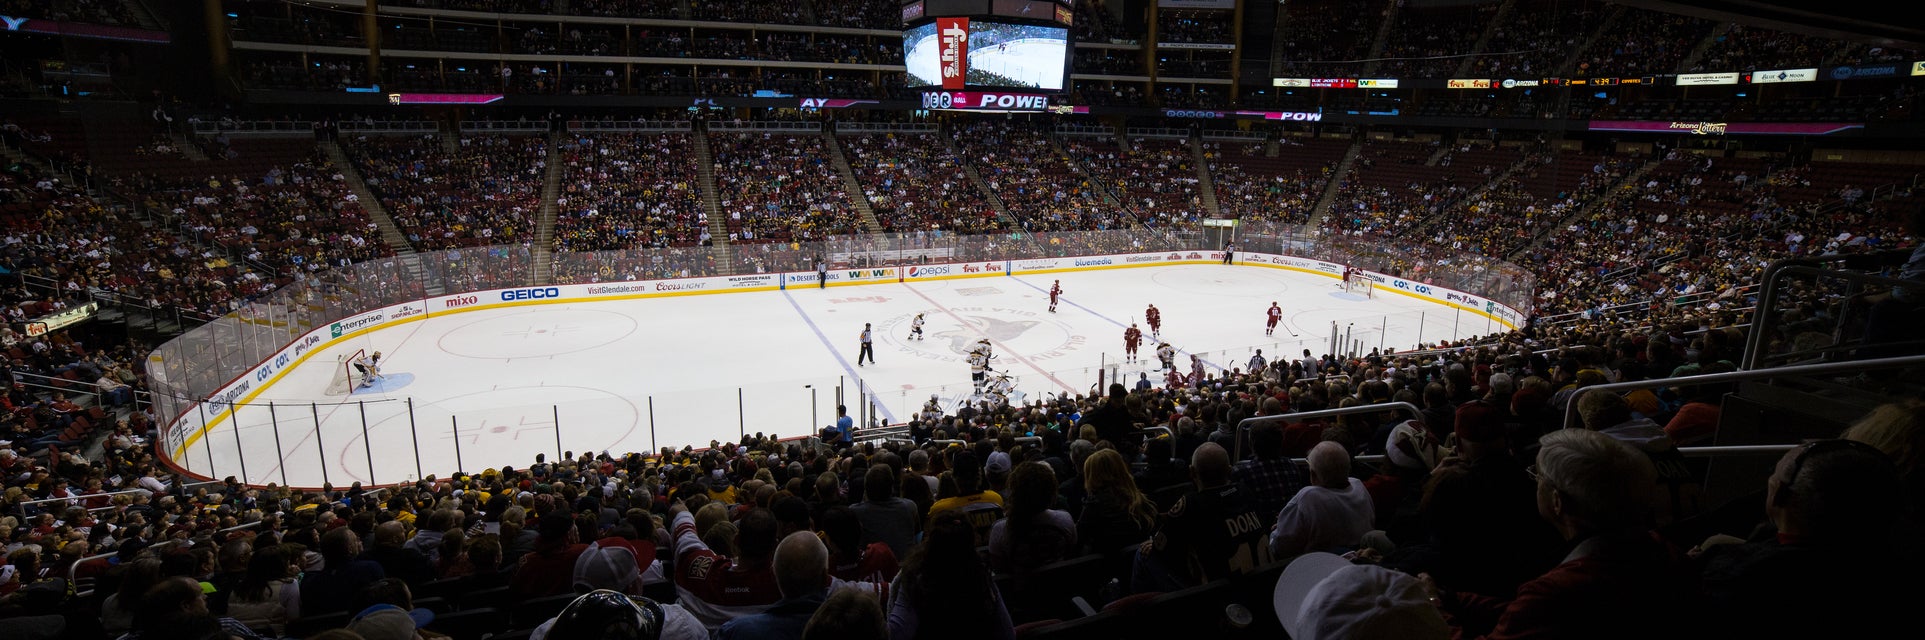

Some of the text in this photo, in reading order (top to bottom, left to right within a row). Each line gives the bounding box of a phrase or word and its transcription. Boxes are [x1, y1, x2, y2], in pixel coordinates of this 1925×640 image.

[942, 22, 967, 78] fry's
[1670, 121, 1699, 129] Arizona
[1075, 257, 1112, 267] bluemedia
[919, 265, 950, 276] pepsi
[962, 264, 980, 273] fry's
[985, 263, 1002, 272] fry's
[796, 274, 816, 282] DESERT
[588, 285, 645, 294] VisitGlendale.com
[656, 281, 706, 291] Coors LIGHT
[1393, 279, 1410, 290] COX
[501, 287, 559, 301] GEICO
[1415, 285, 1432, 295] COX
[275, 353, 290, 368] COX
[257, 365, 273, 382] COX
[226, 381, 250, 402] ARIZONA
[1226, 512, 1262, 537] DOAN
